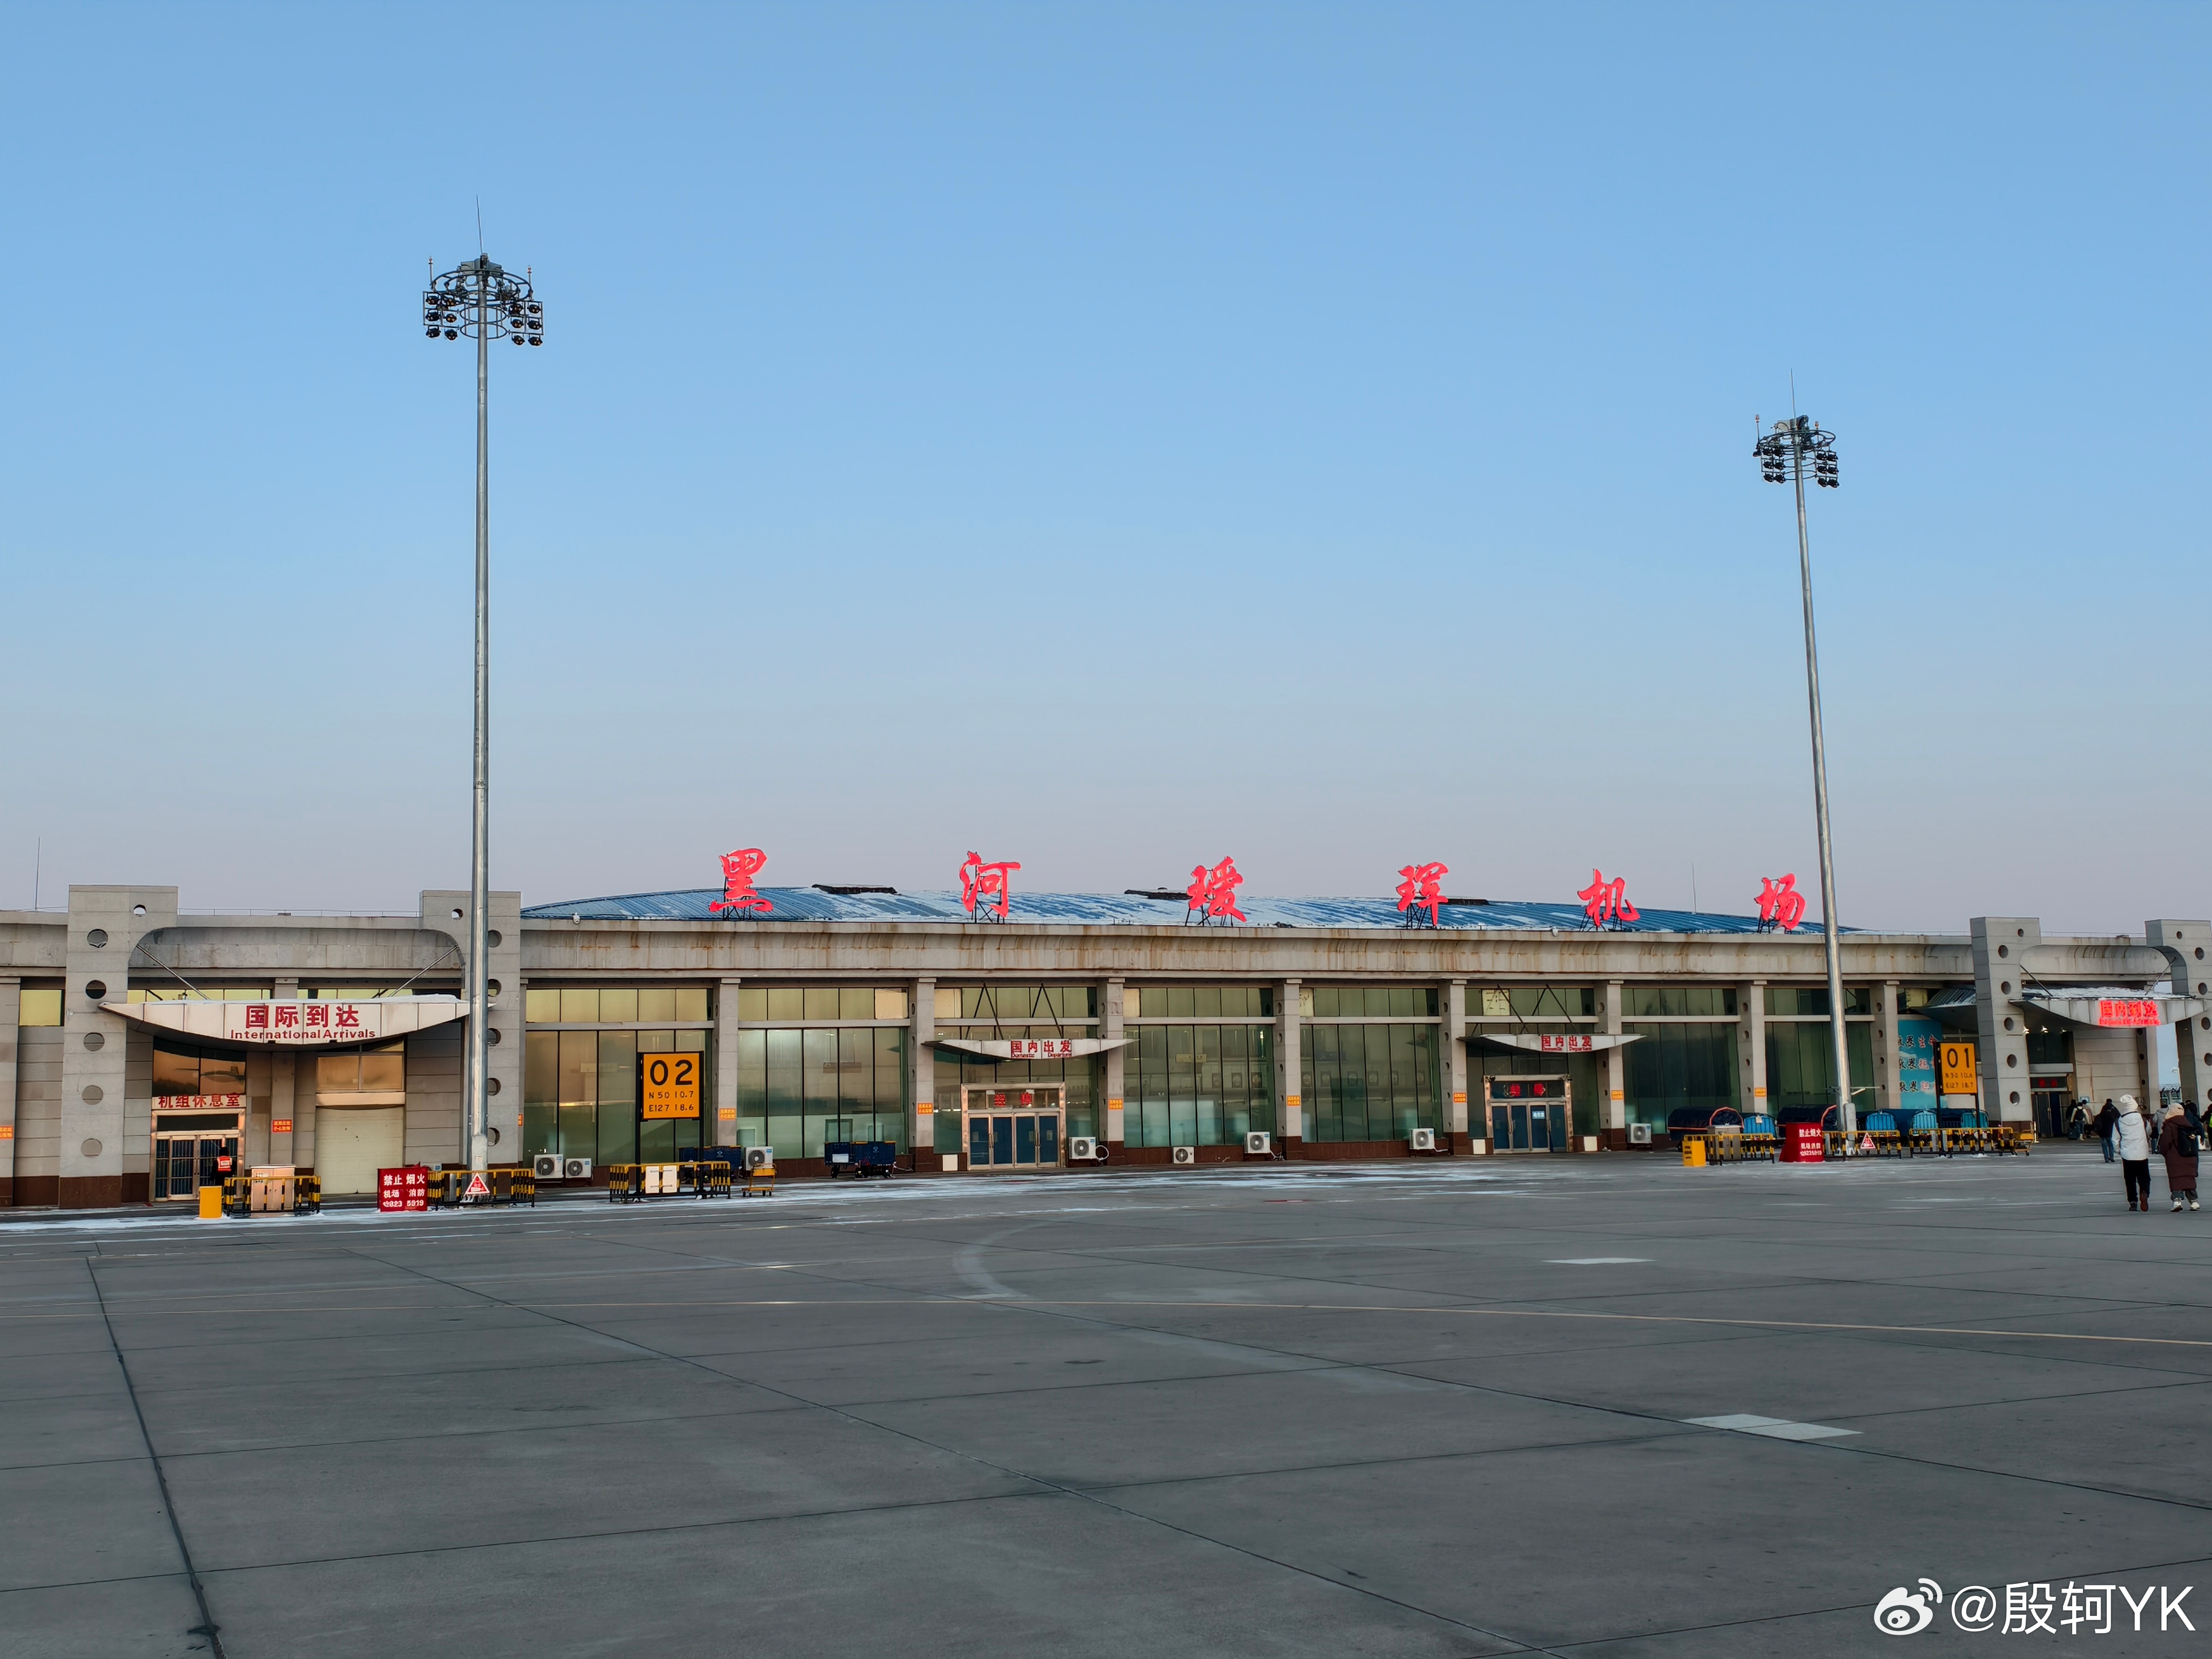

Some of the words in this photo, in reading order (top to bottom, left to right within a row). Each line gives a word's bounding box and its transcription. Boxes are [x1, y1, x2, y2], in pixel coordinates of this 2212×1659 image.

[246, 1004, 359, 1028] 国际到达
[2100, 1000, 2159, 1017] 国内到达
[231, 1029, 320, 1039] International
[323, 1029, 376, 1038] Arrivals
[1542, 1035, 1591, 1047] 国内出发
[1011, 1040, 1071, 1053] 国内出发
[1947, 1048, 1970, 1068] 01
[650, 1060, 693, 1085] 02
[158, 1092, 240, 1109] 机组休息室
